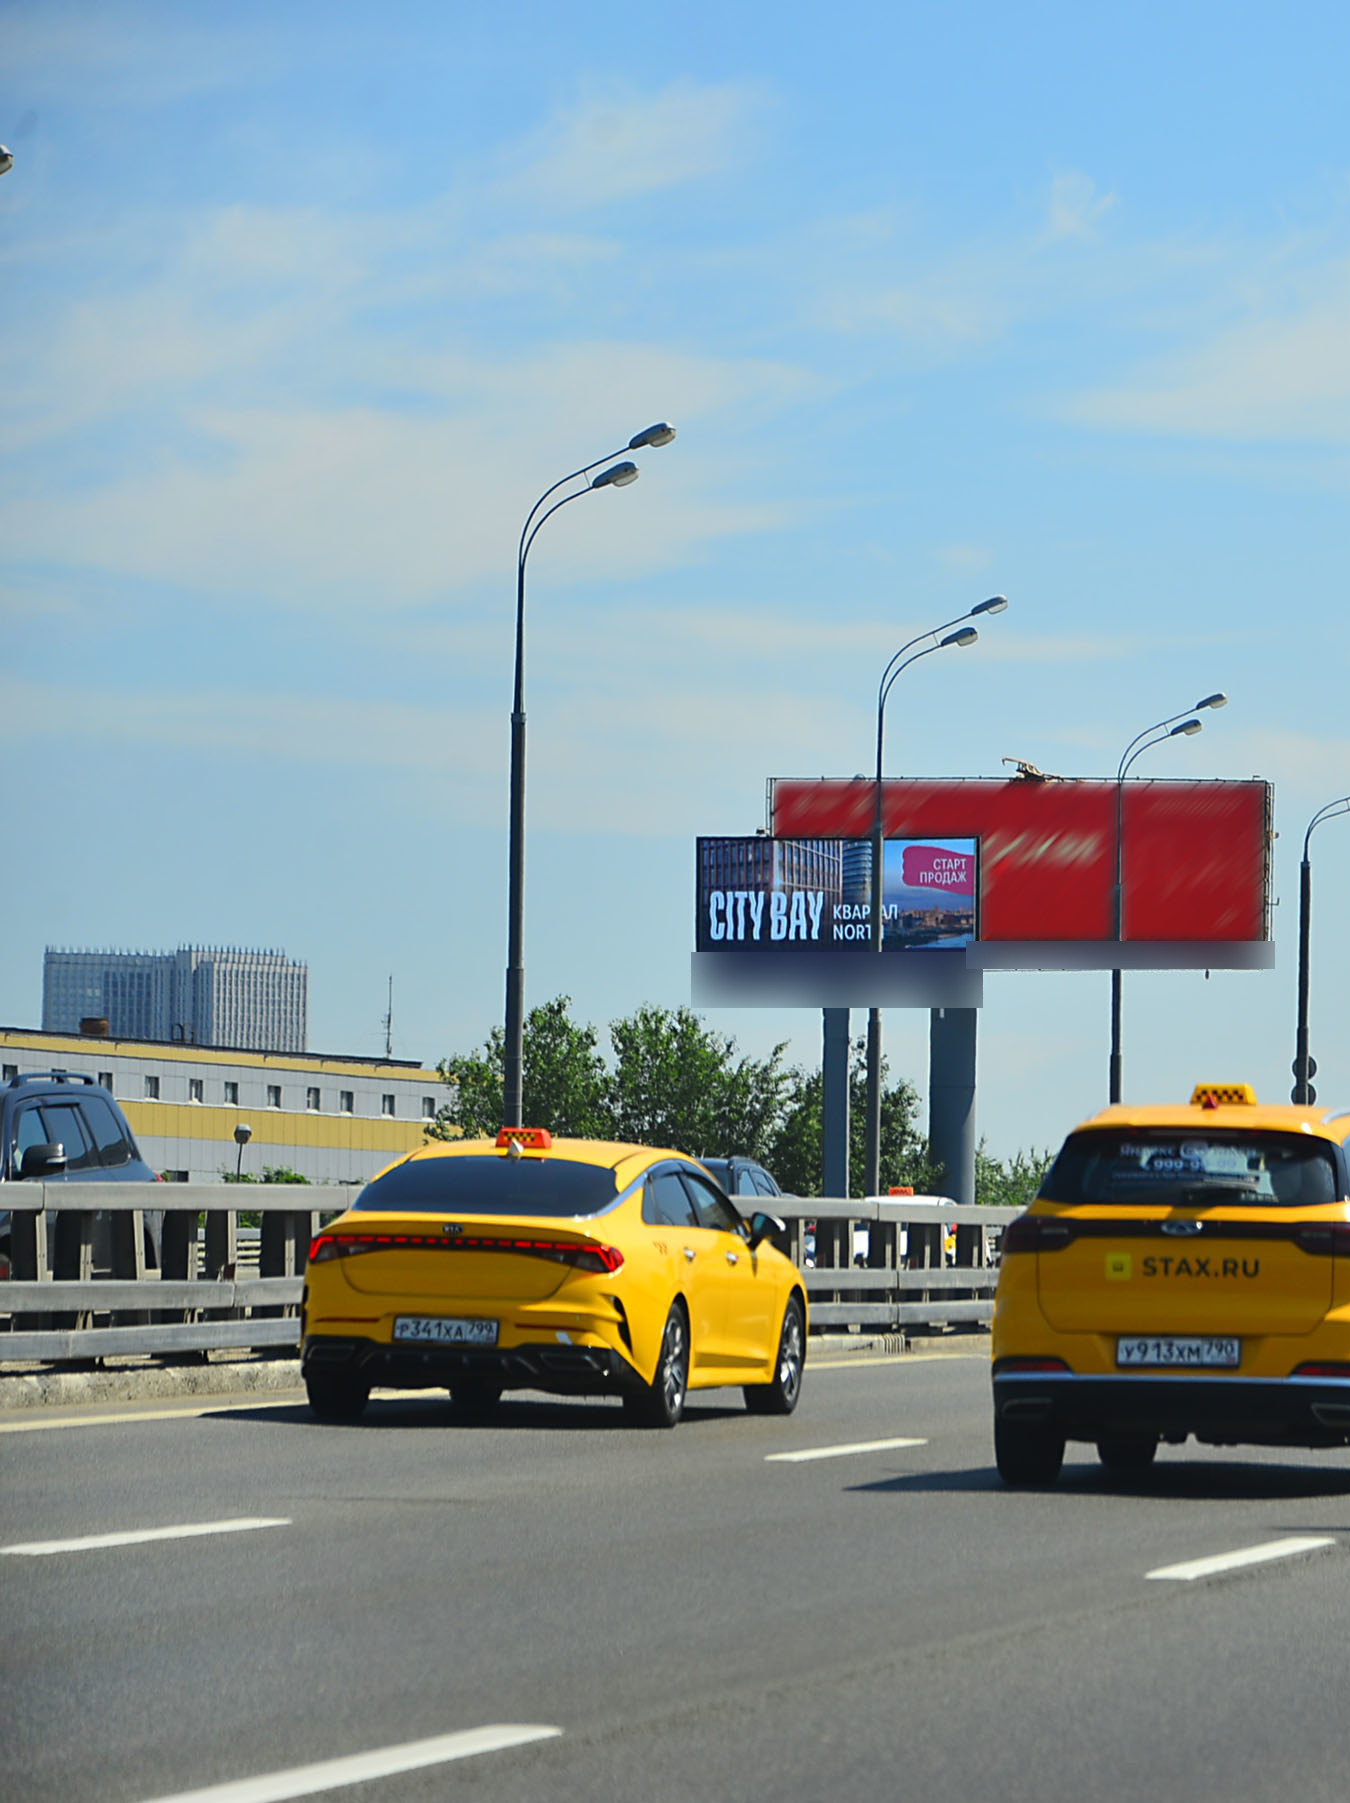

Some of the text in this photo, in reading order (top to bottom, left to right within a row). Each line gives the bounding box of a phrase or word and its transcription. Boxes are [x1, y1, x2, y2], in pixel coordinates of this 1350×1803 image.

[933, 858, 967, 870] СТАРТ
[919, 871, 967, 884] ПРОДАЖ
[709, 891, 824, 941] CITY BAY
[833, 904, 898, 920] КВАРАЛ
[833, 924, 885, 940] NORT
[1143, 1257, 1260, 1278] STAX.RU
